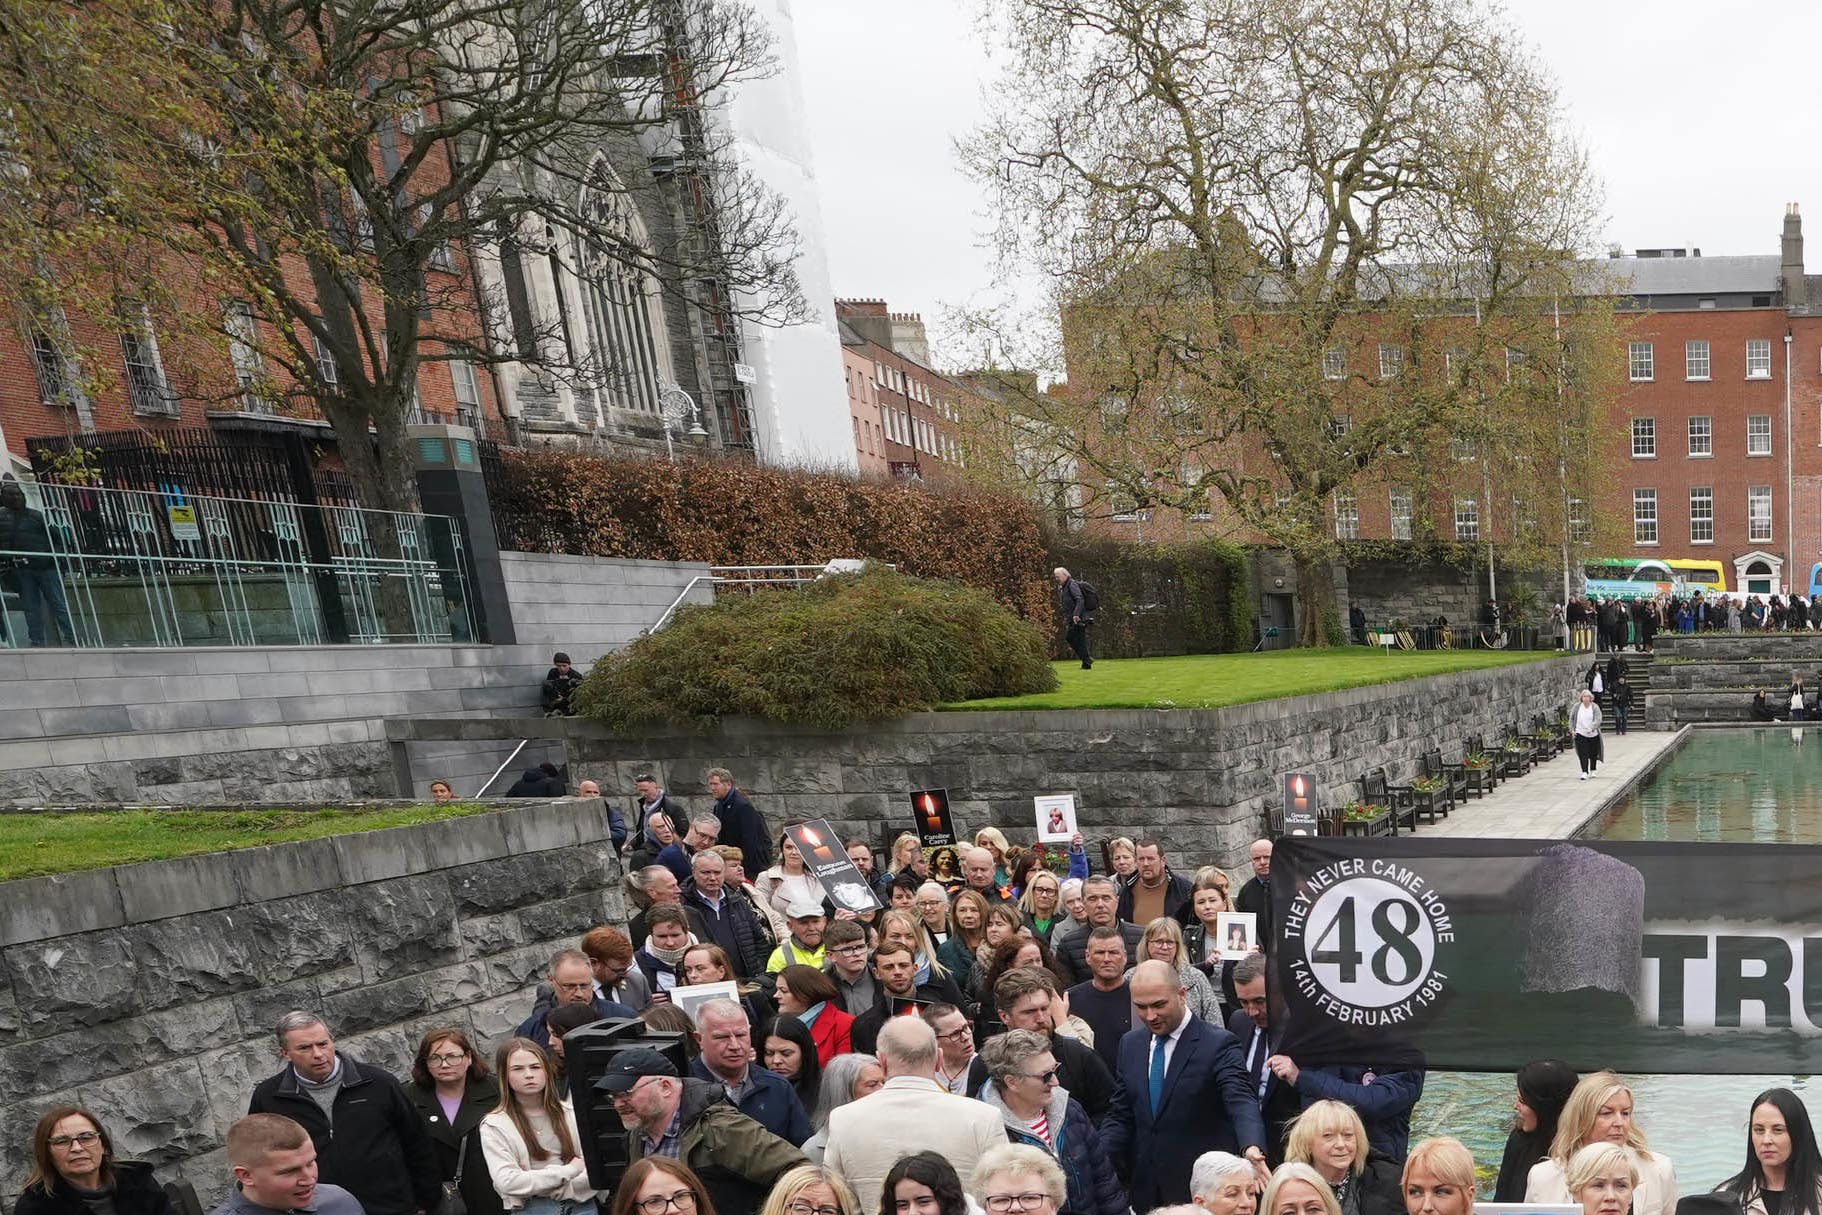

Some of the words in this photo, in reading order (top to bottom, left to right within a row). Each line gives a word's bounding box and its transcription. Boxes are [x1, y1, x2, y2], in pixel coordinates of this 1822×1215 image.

[1284, 890, 1312, 939] THEY
[1307, 858, 1366, 894] NEVER
[1371, 859, 1424, 893] CAME
[1420, 889, 1455, 944] HOME
[1311, 896, 1422, 986] 48
[1290, 959, 1315, 998] 14th
[1315, 993, 1414, 1026] FEBRUARY
[1416, 970, 1448, 1008] 1981
